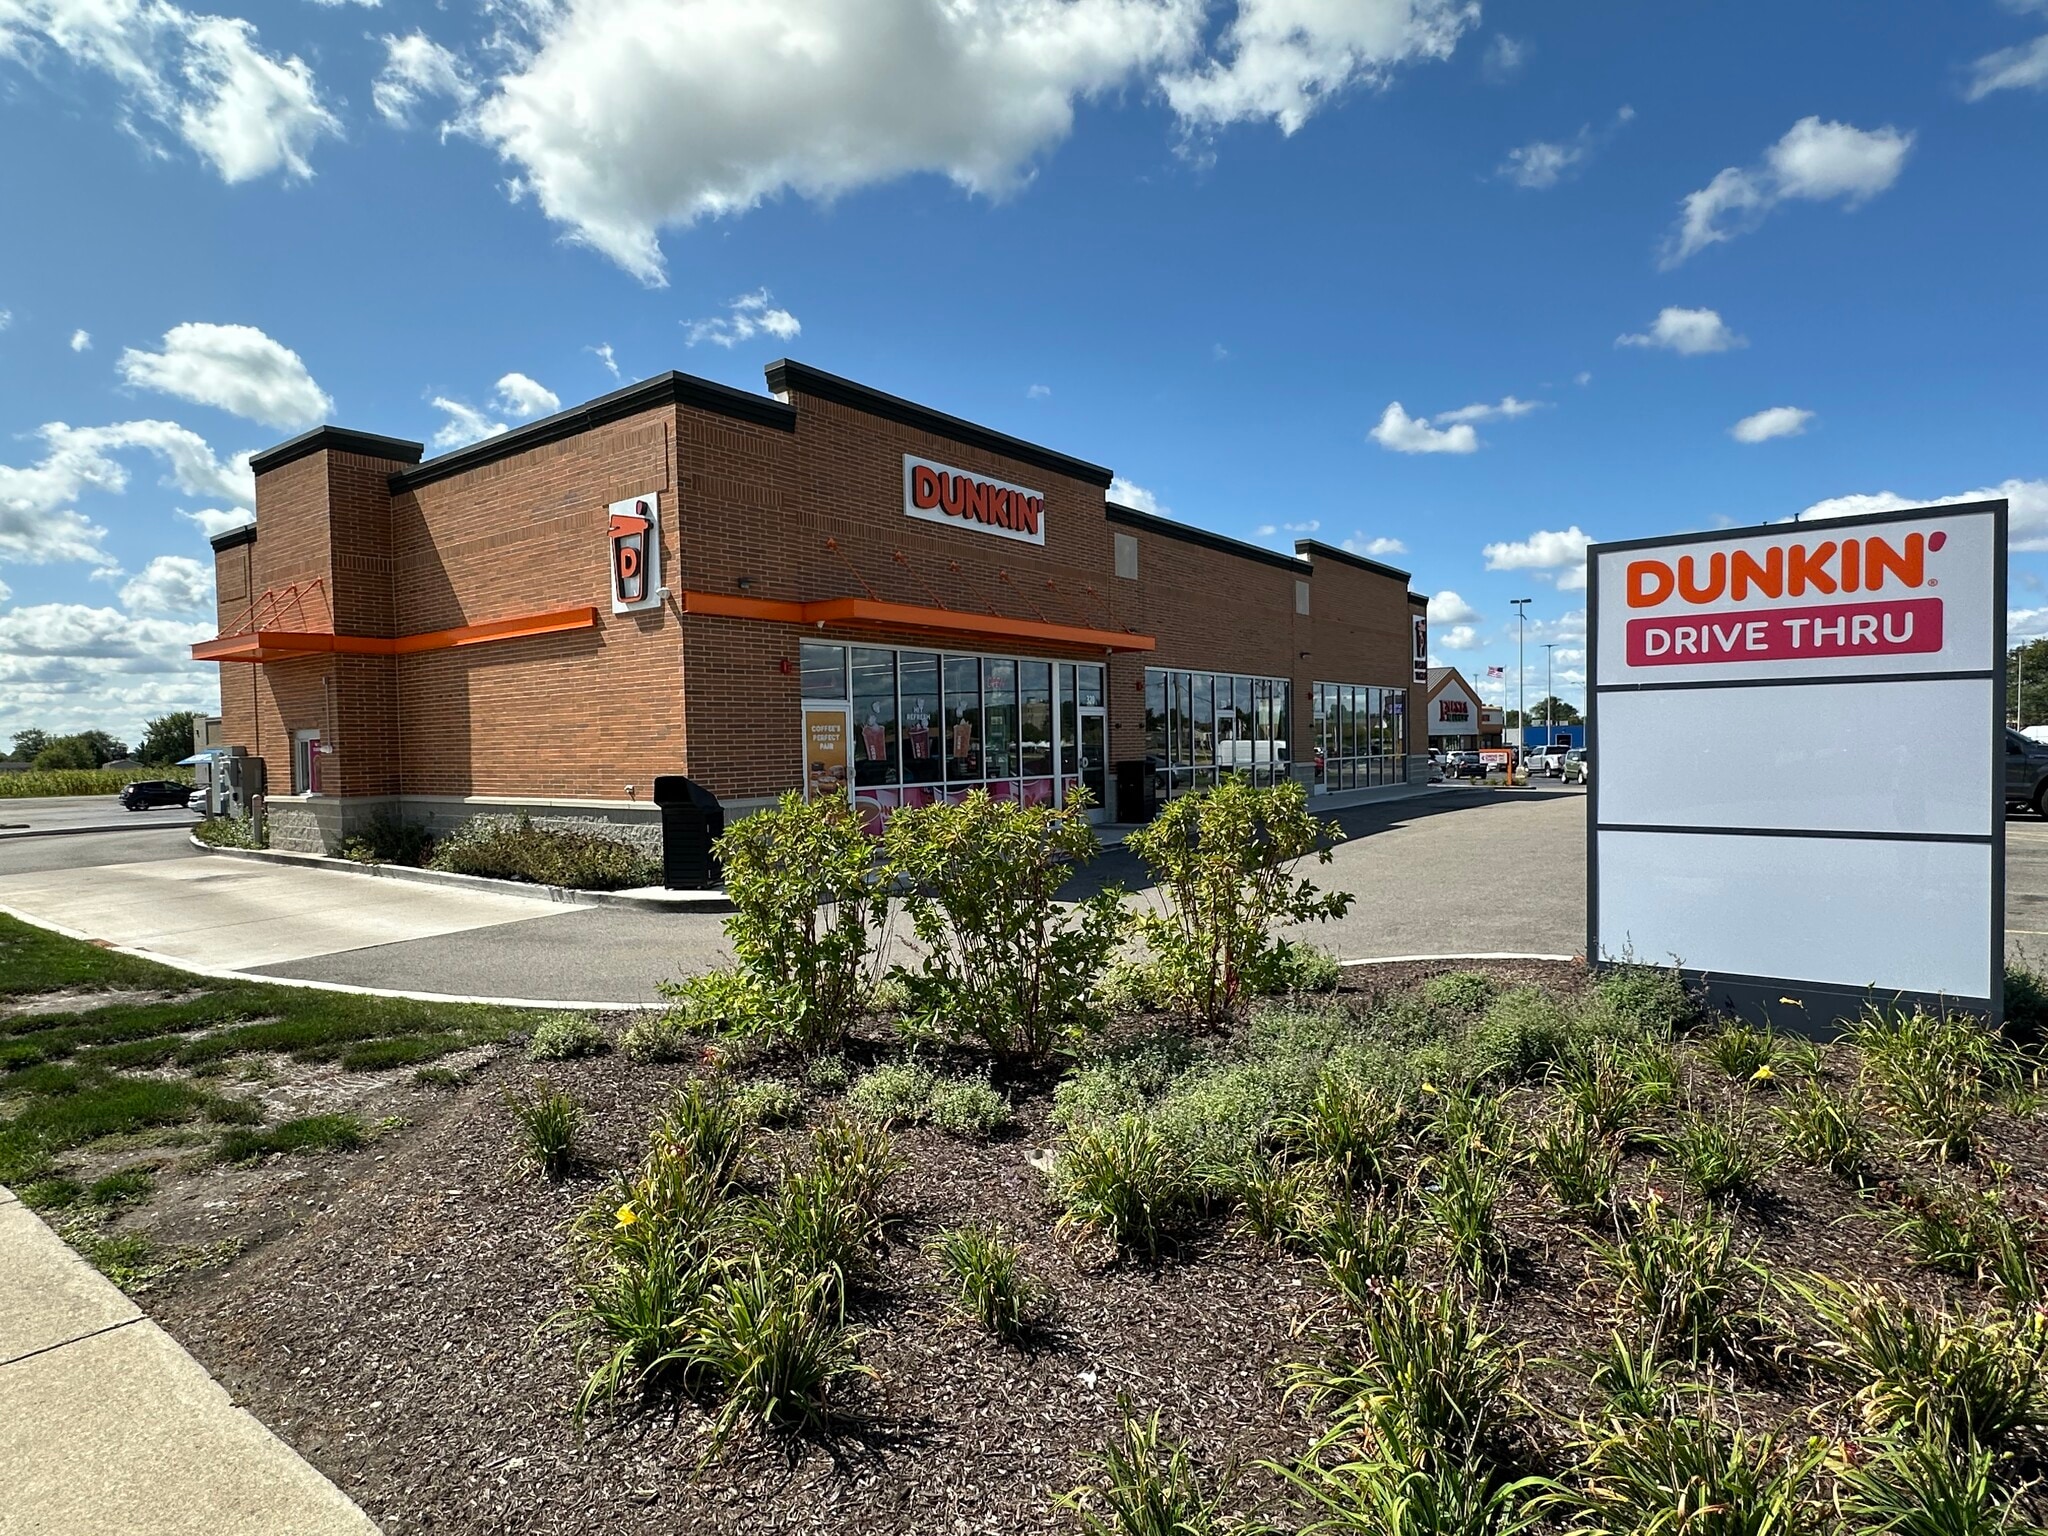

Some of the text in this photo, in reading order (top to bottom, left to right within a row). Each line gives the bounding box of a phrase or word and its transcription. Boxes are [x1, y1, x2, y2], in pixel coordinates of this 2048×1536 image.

[912, 465, 1044, 534] DUNKIN'
[1626, 531, 1947, 609] DUNKIN'
[1645, 611, 1914, 657] DRIVE THRU
